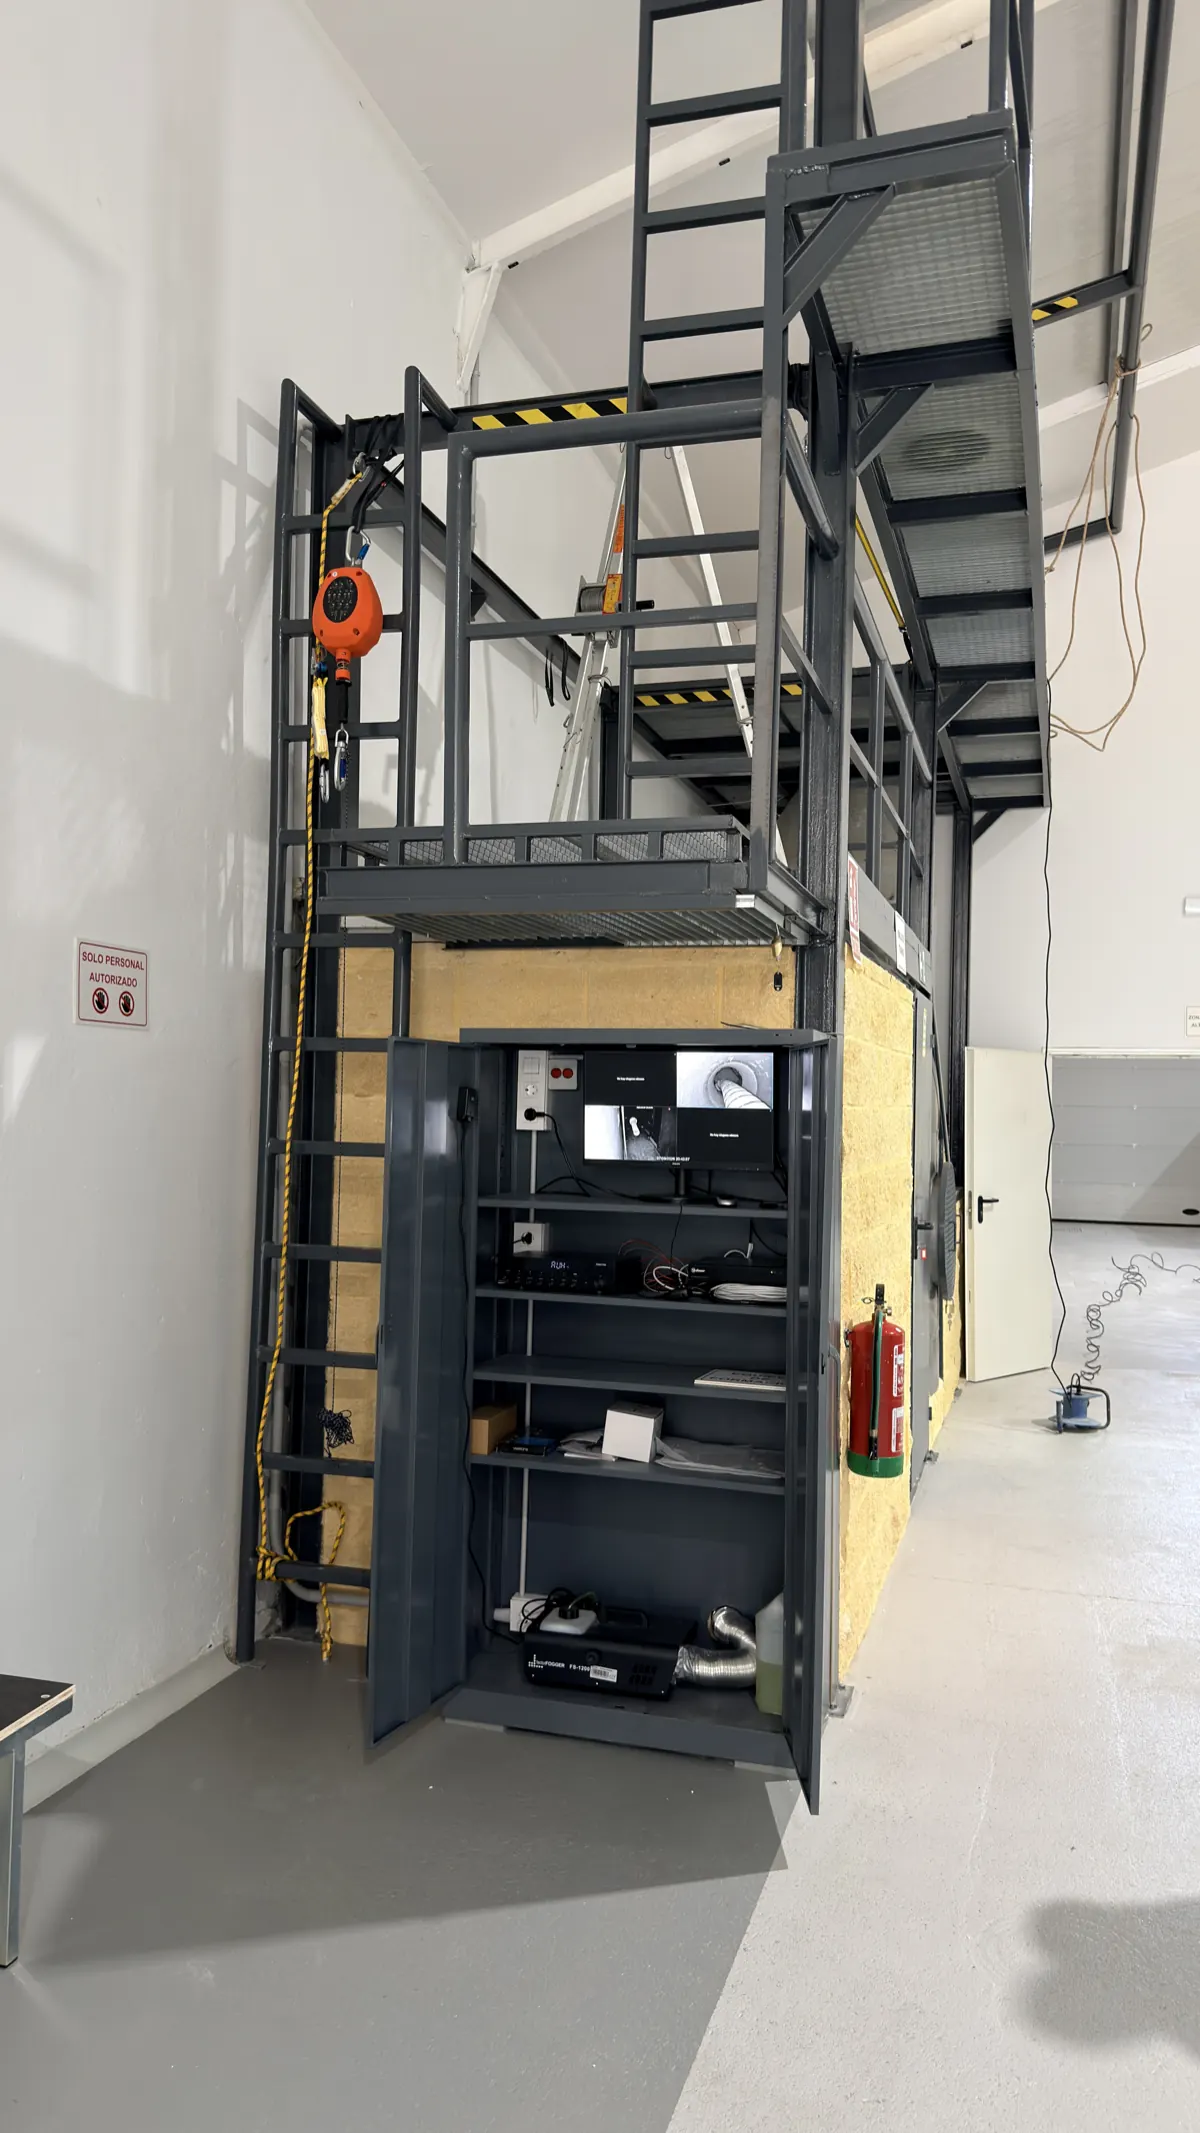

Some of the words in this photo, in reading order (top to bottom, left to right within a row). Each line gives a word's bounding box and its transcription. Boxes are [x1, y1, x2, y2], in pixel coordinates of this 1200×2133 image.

[82, 951, 104, 964] SOLO
[105, 955, 145, 971] PERSONAL
[89, 972, 138, 988] AUTORIZADO
